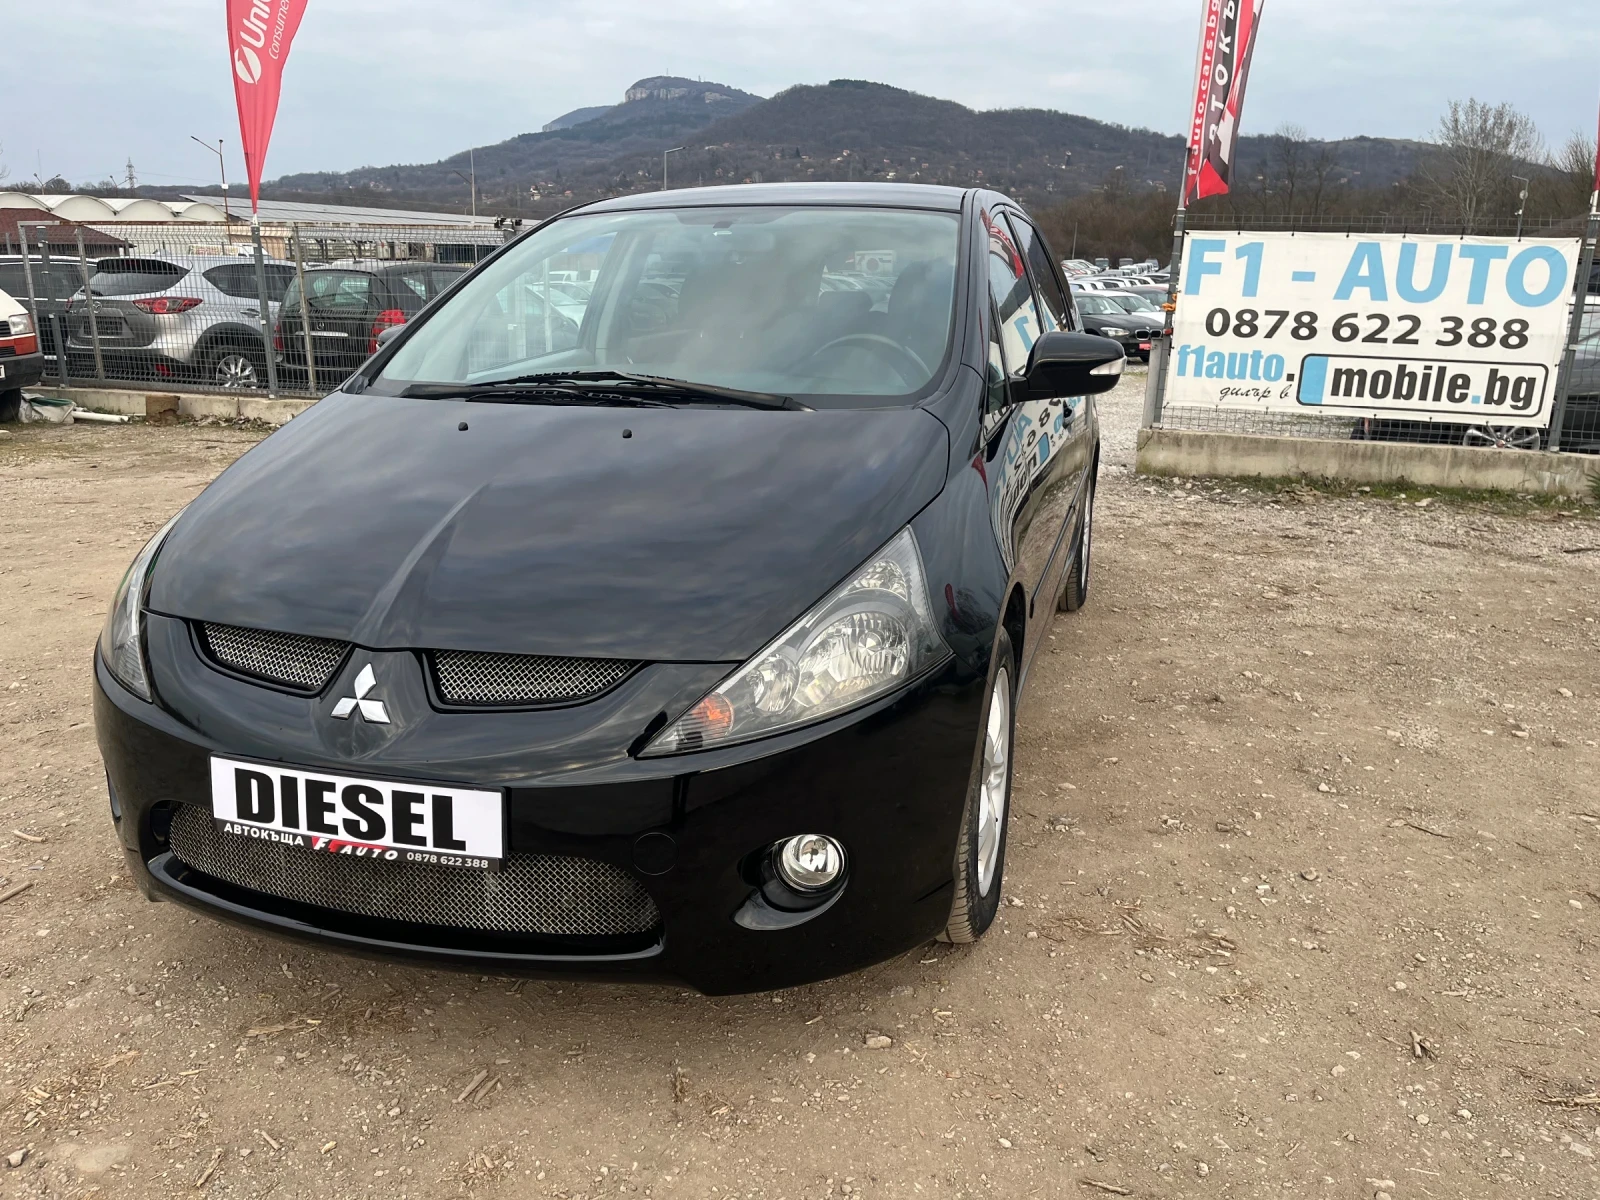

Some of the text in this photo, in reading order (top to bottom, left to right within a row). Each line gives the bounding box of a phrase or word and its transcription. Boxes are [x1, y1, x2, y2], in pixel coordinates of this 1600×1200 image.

[240, 0, 271, 48] Uni
[1185, 239, 1569, 308] F1 - AUTO
[1205, 308, 1530, 350] 0878 622 388
[1330, 363, 1537, 411] mobile.bg
[234, 767, 467, 852] DIESEL
[224, 822, 304, 846] АВТОКЪЩА
[340, 845, 399, 861] AUTO
[406, 852, 489, 869] 0878 622 388
